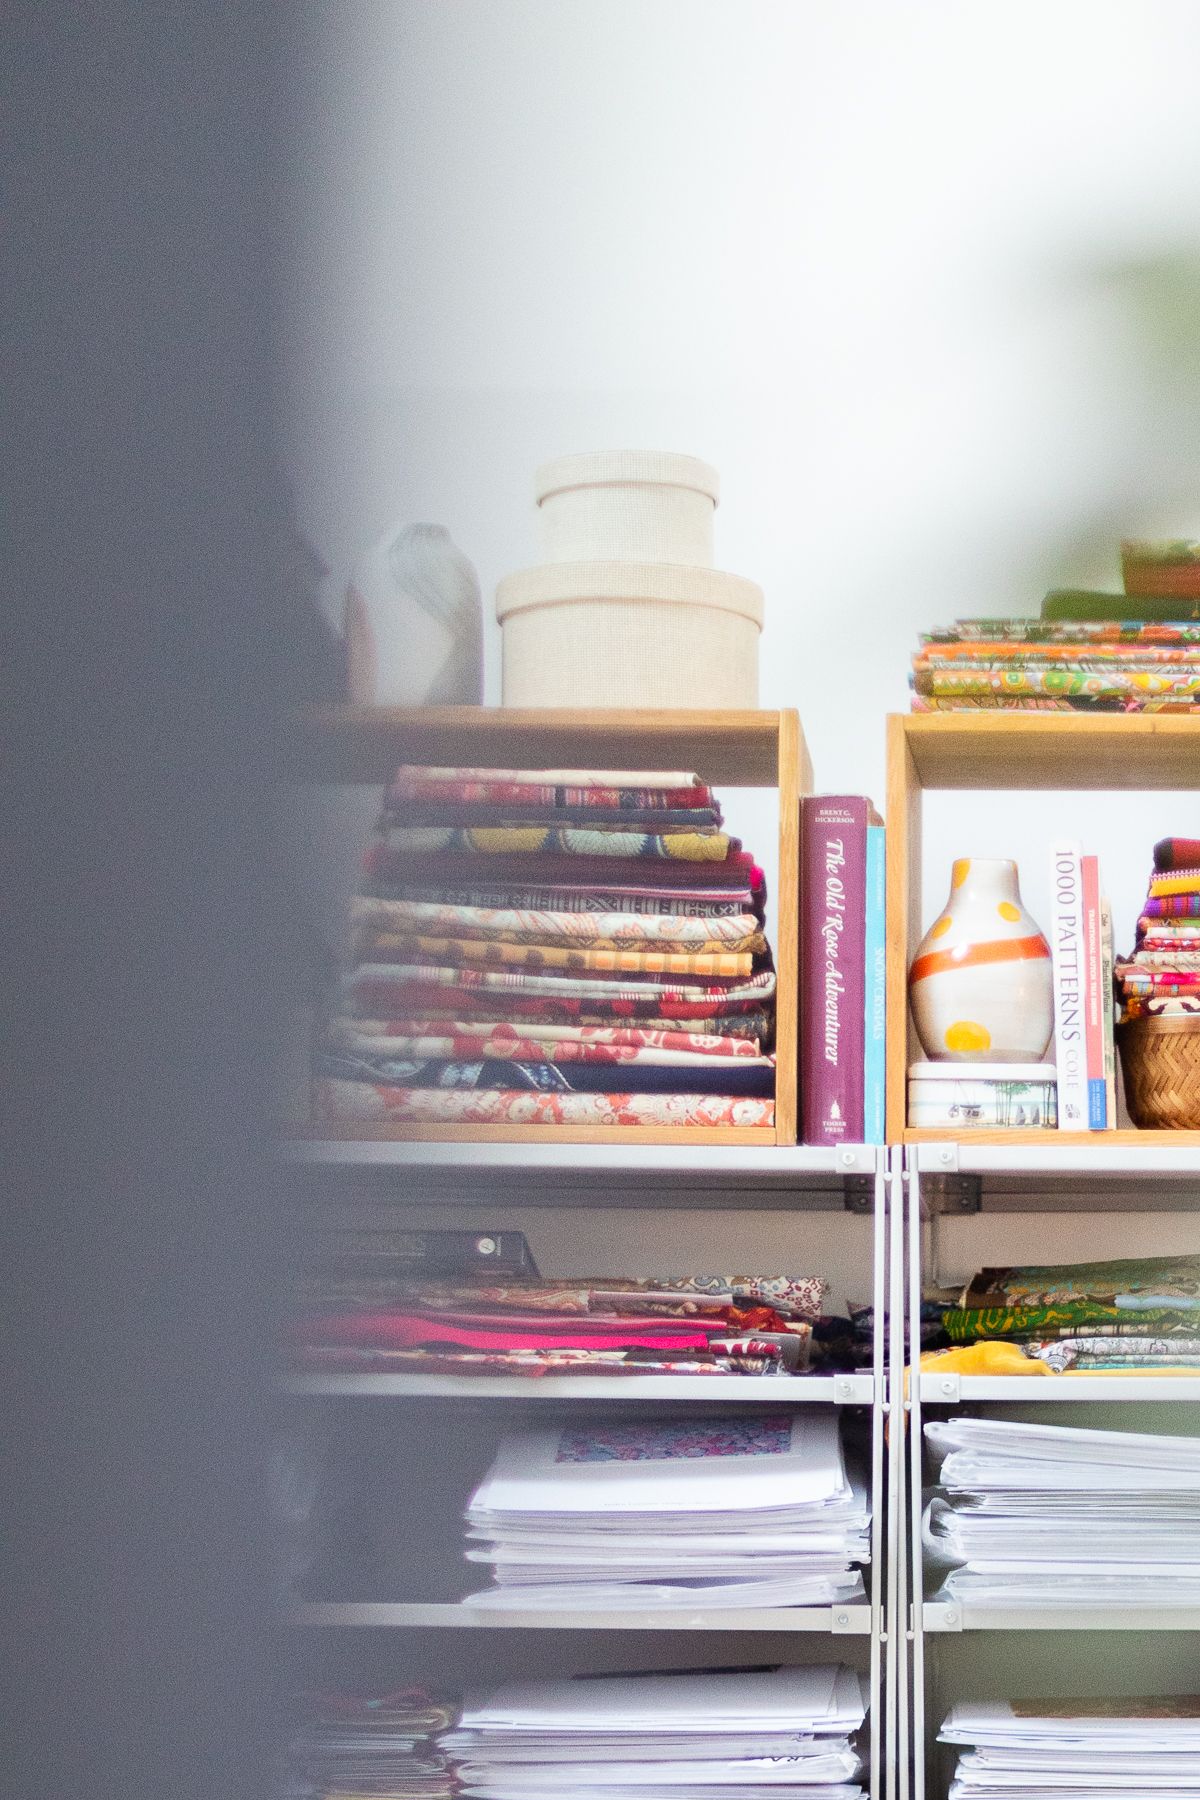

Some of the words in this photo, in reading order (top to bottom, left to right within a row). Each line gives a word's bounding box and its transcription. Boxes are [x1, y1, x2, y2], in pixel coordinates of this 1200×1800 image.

[826, 838, 845, 874] The
[826, 874, 846, 911] Old
[1056, 850, 1076, 905] 1000
[822, 913, 844, 958] Rose
[1088, 908, 1096, 954] TRADITIONAL
[875, 947, 886, 983] SNOW
[1058, 915, 1080, 1041] PATTERNS
[1089, 956, 1097, 980] DUTCH
[1102, 960, 1110, 983] Plants
[825, 956, 845, 1066] Adventurer
[873, 987, 885, 1040] CRYSTALS
[1065, 1049, 1078, 1088] COLE
